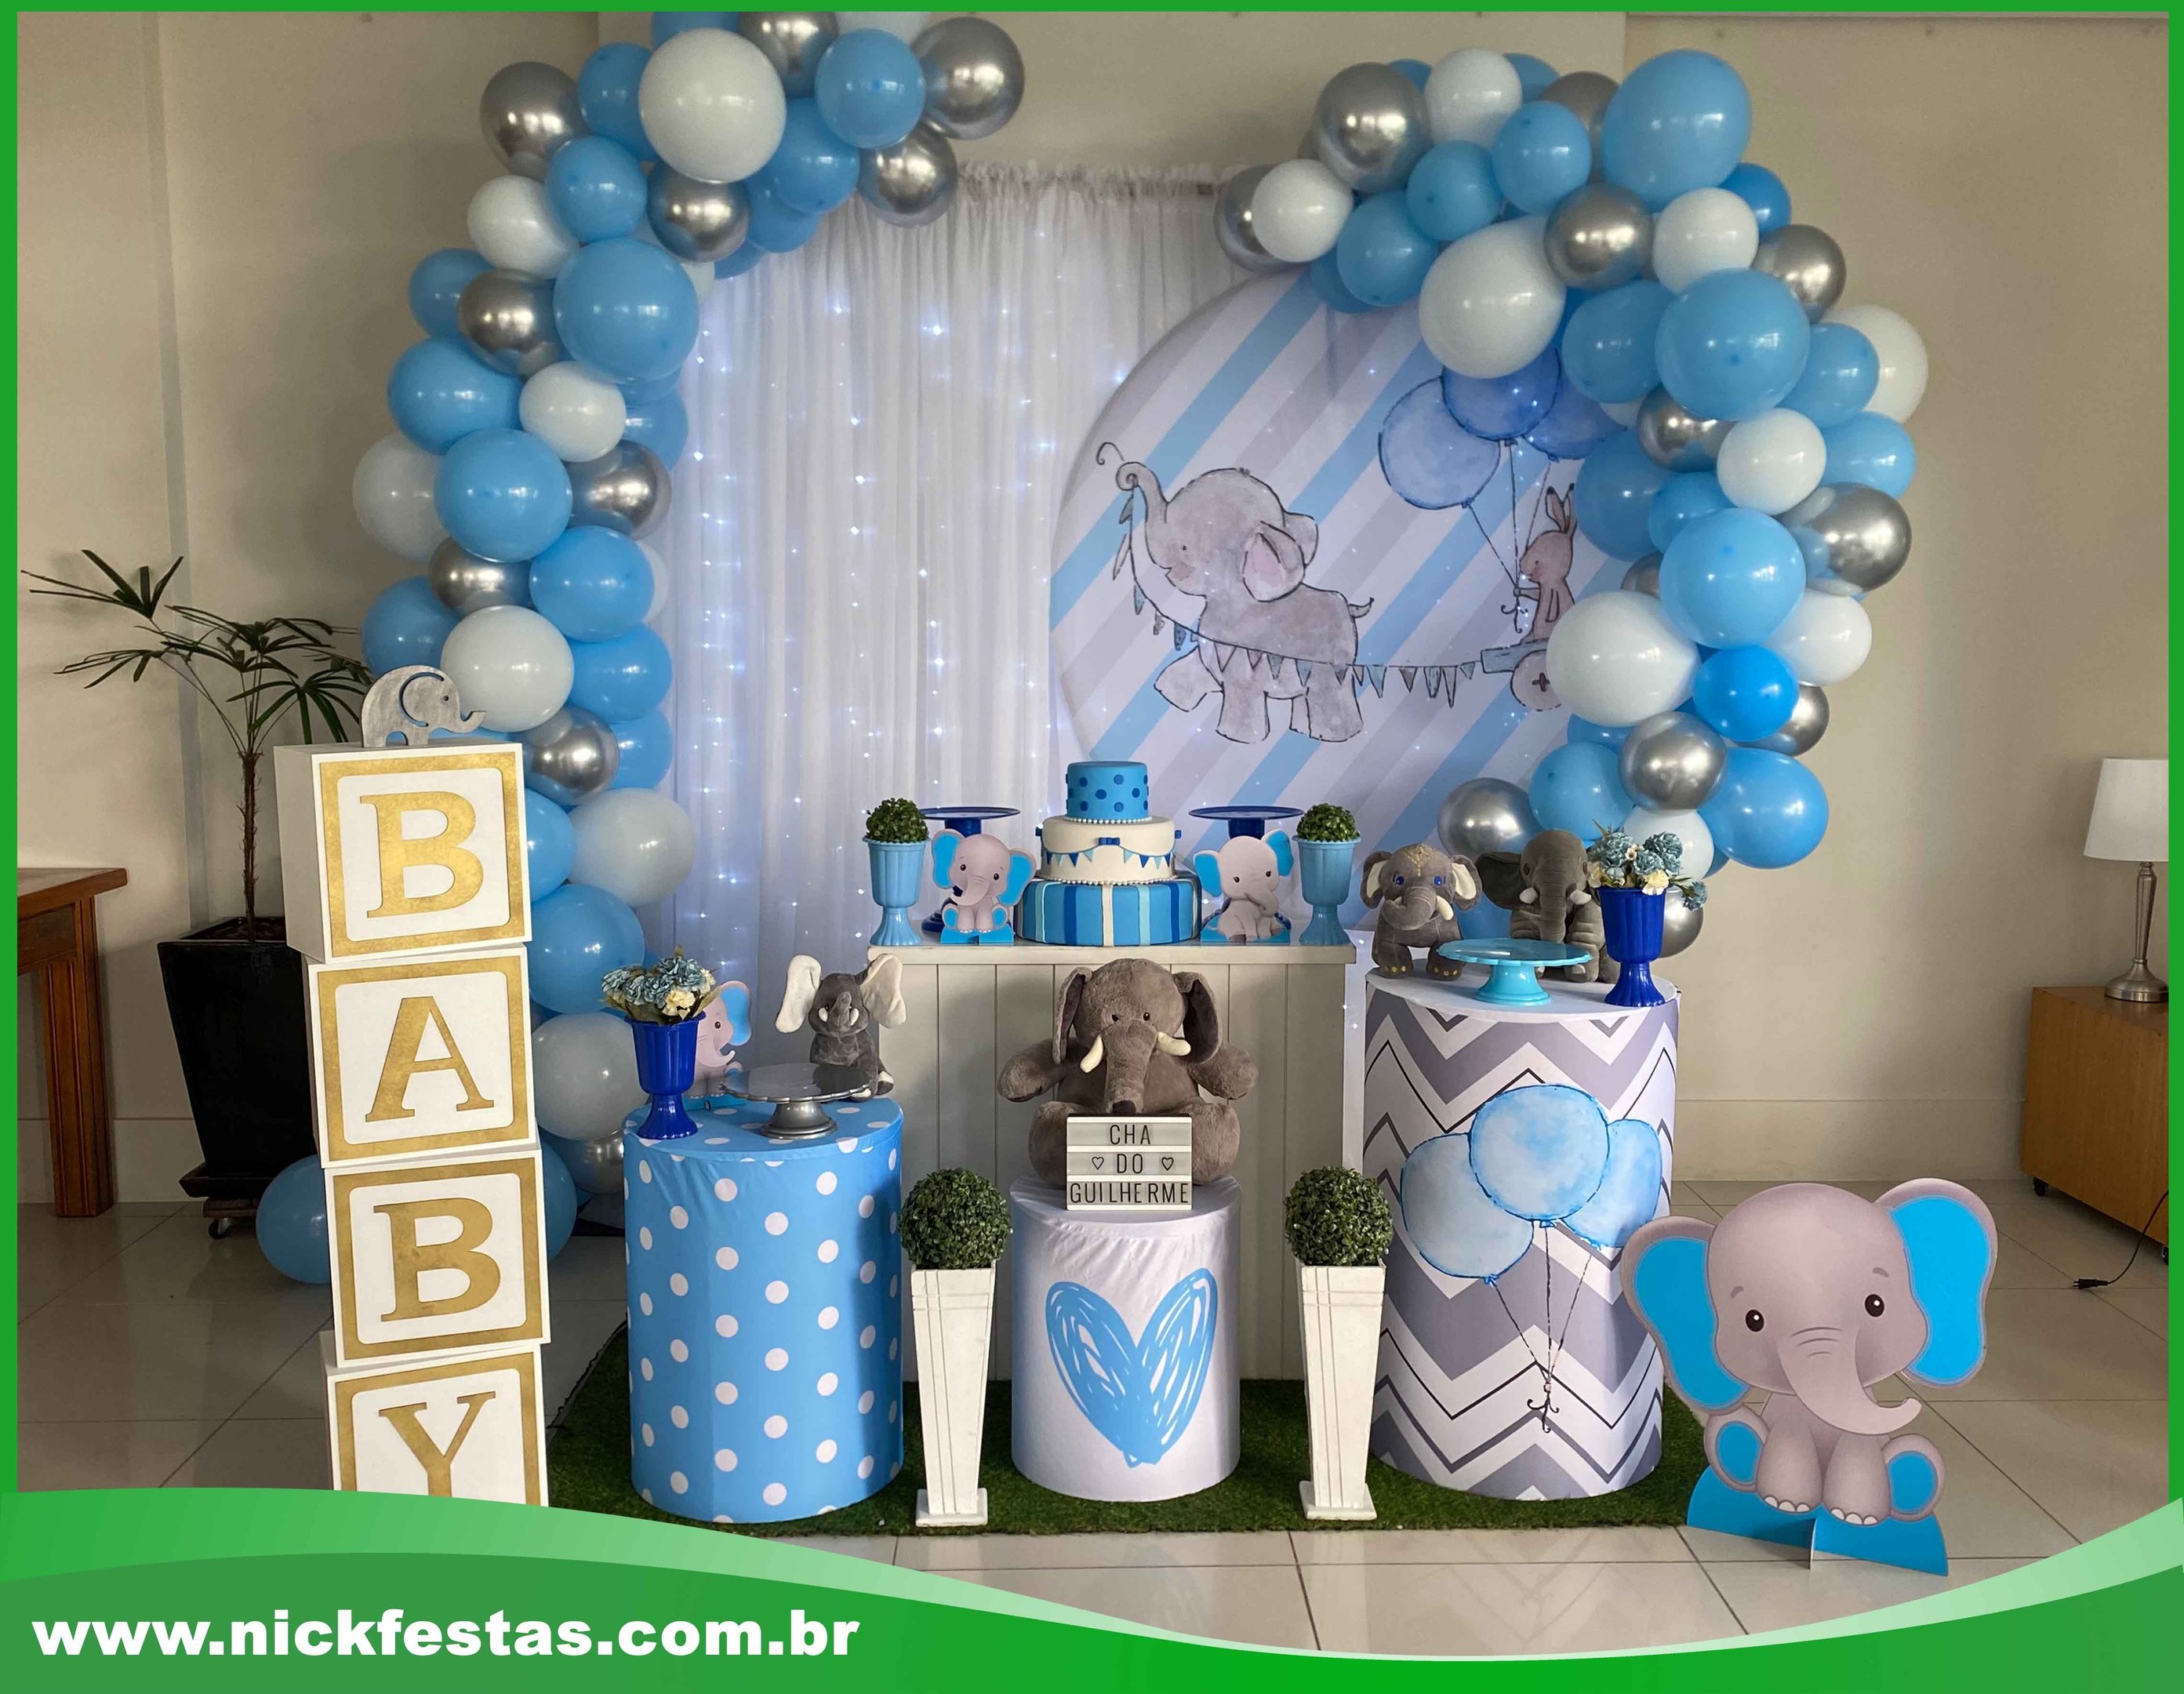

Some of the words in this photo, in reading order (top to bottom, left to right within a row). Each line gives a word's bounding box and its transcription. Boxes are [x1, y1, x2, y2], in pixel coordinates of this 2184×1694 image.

[359, 791, 501, 1498] BABY
[1109, 1124, 1151, 1145] CHA
[1116, 1154, 1144, 1174] DO
[1070, 1183, 1189, 1203] GUILHERME
